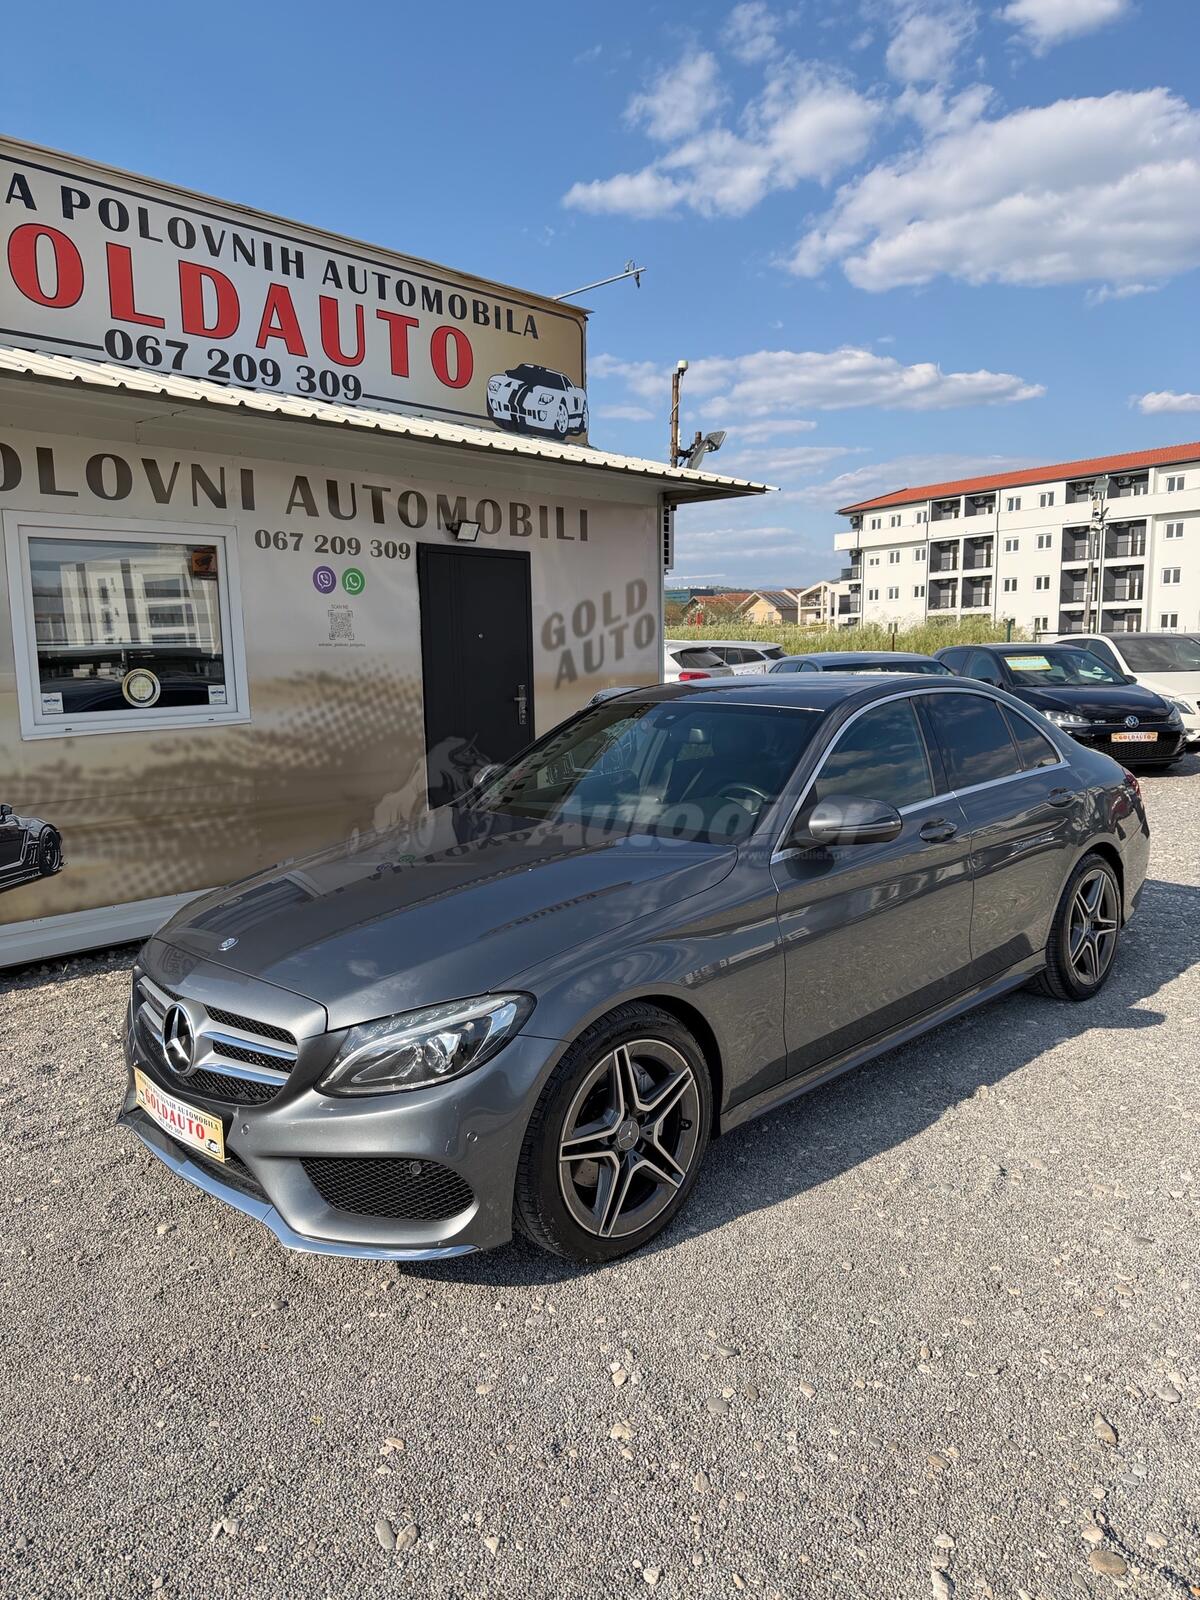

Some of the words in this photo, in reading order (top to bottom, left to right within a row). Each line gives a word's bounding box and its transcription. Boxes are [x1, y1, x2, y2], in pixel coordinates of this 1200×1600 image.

[6, 172, 37, 211] A
[61, 185, 305, 280] POLOVNIH
[321, 259, 539, 340] AUTOMOBILA
[7, 222, 475, 390] OLDAUTO
[104, 328, 190, 371] 067
[206, 348, 282, 388] 209
[296, 365, 363, 401] 309
[254, 529, 304, 551] 067
[314, 534, 362, 556] 209
[370, 539, 411, 560] 309
[285, 475, 589, 542] AUTOMOBILI
[541, 578, 648, 652] GOLD
[555, 612, 656, 690] AUTO
[145, 1088, 205, 1140] GOLDAUTO
